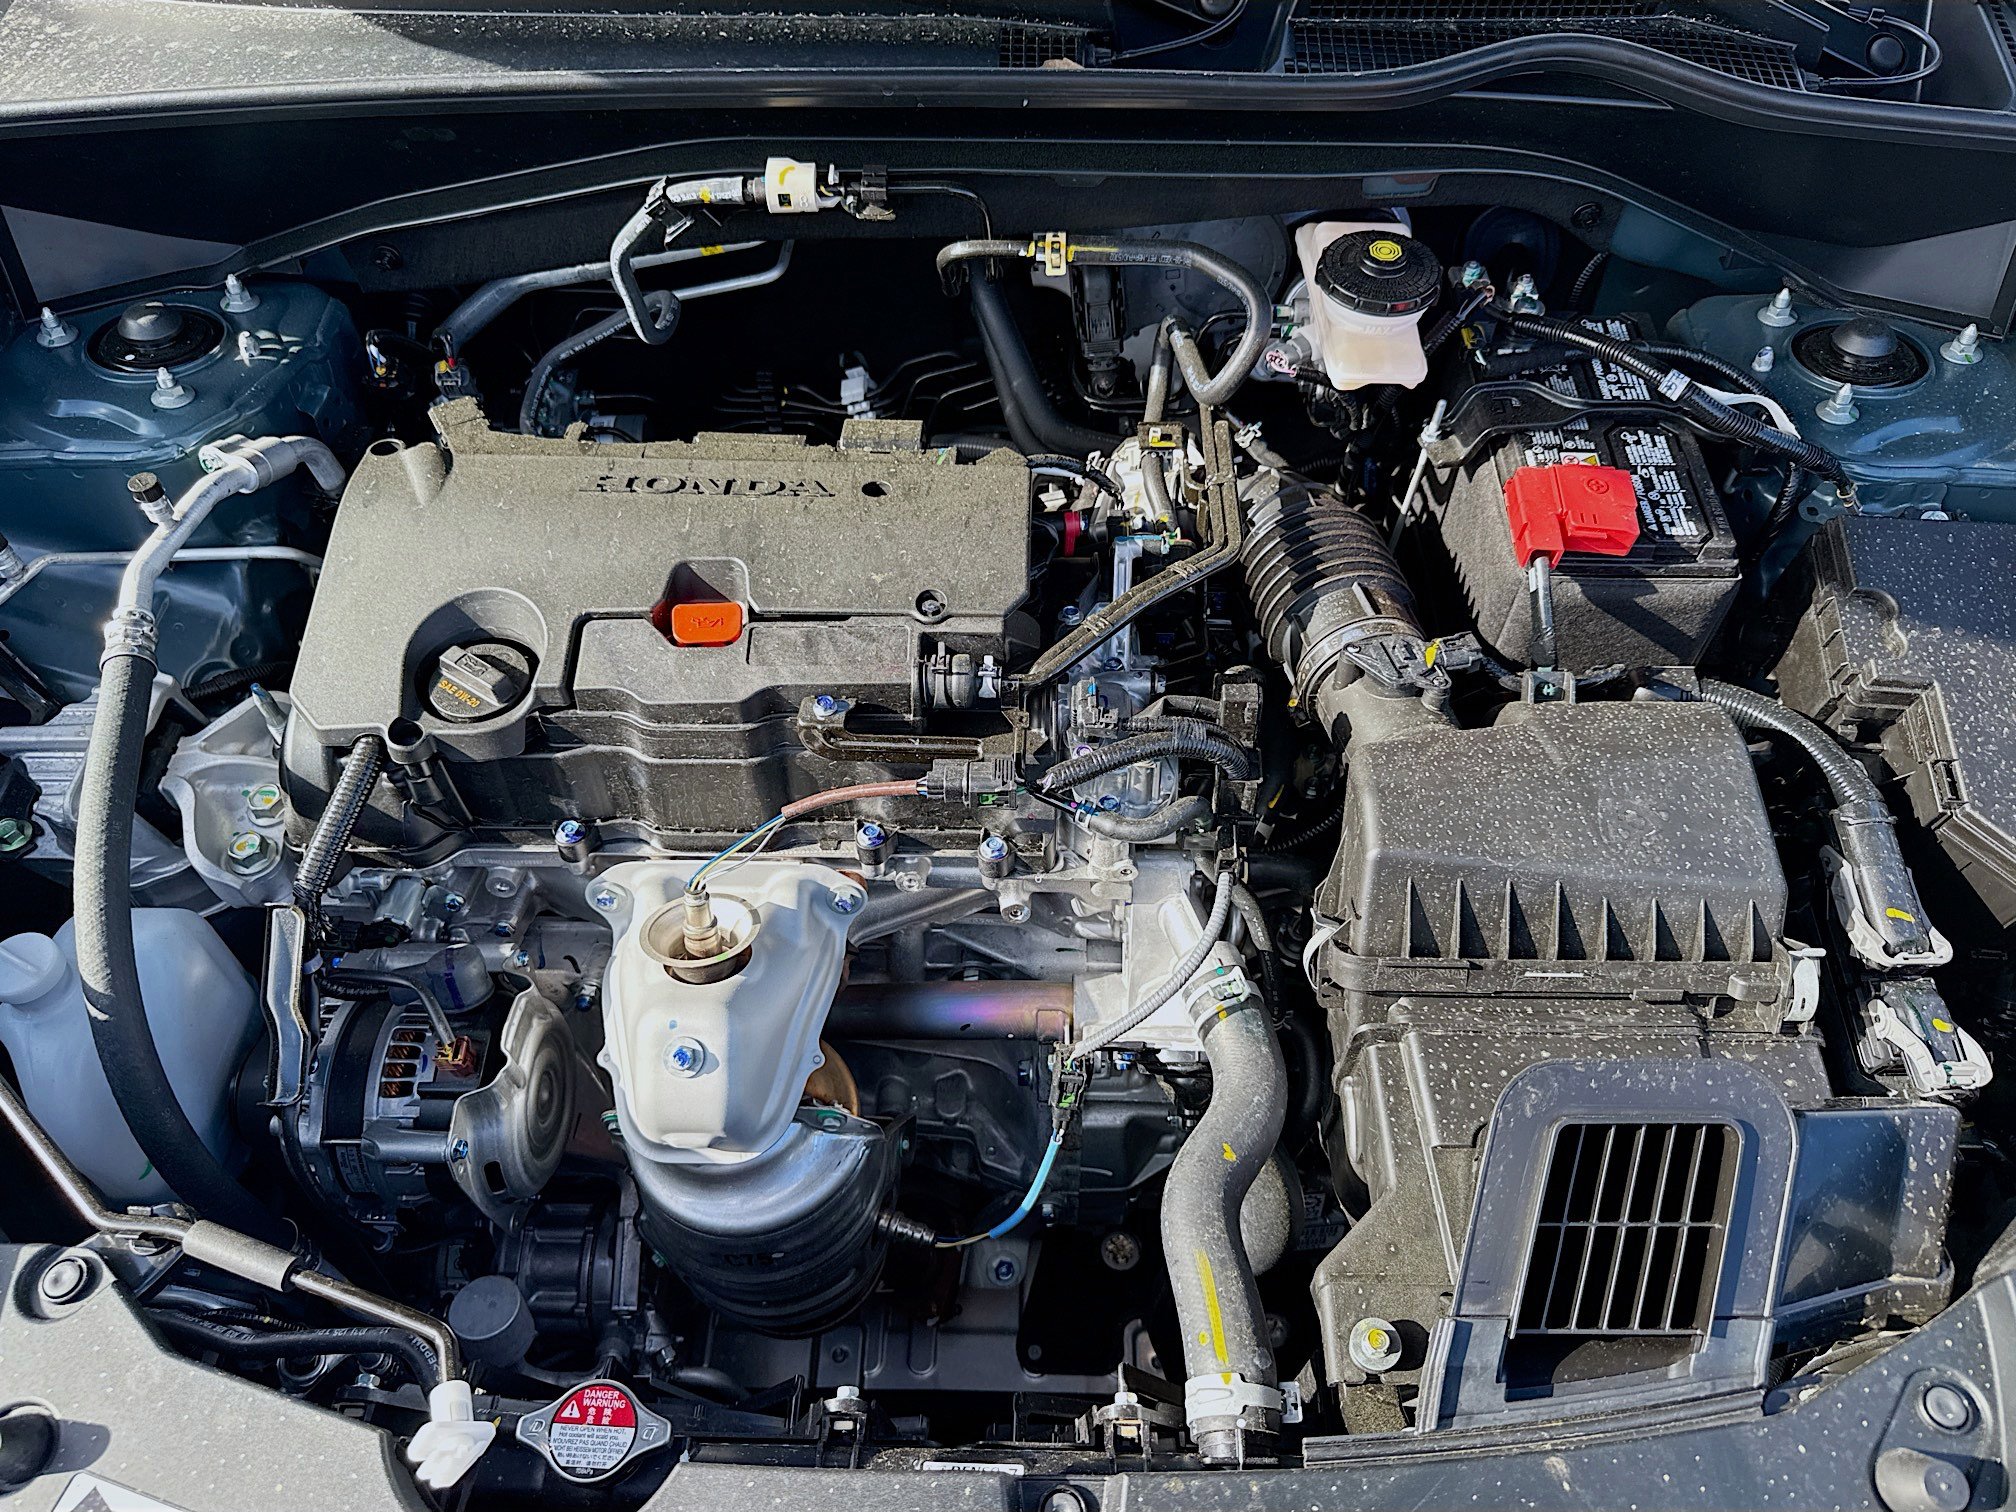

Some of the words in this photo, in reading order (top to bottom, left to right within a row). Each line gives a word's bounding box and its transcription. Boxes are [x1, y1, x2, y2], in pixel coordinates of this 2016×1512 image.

[1364, 325, 1392, 336] MAX
[580, 475, 835, 498] HONDA
[438, 680, 457, 694] SAE
[455, 690, 480, 708] 0W-20
[584, 1390, 619, 1399] DANGER
[583, 1398, 626, 1408] WARNUNG
